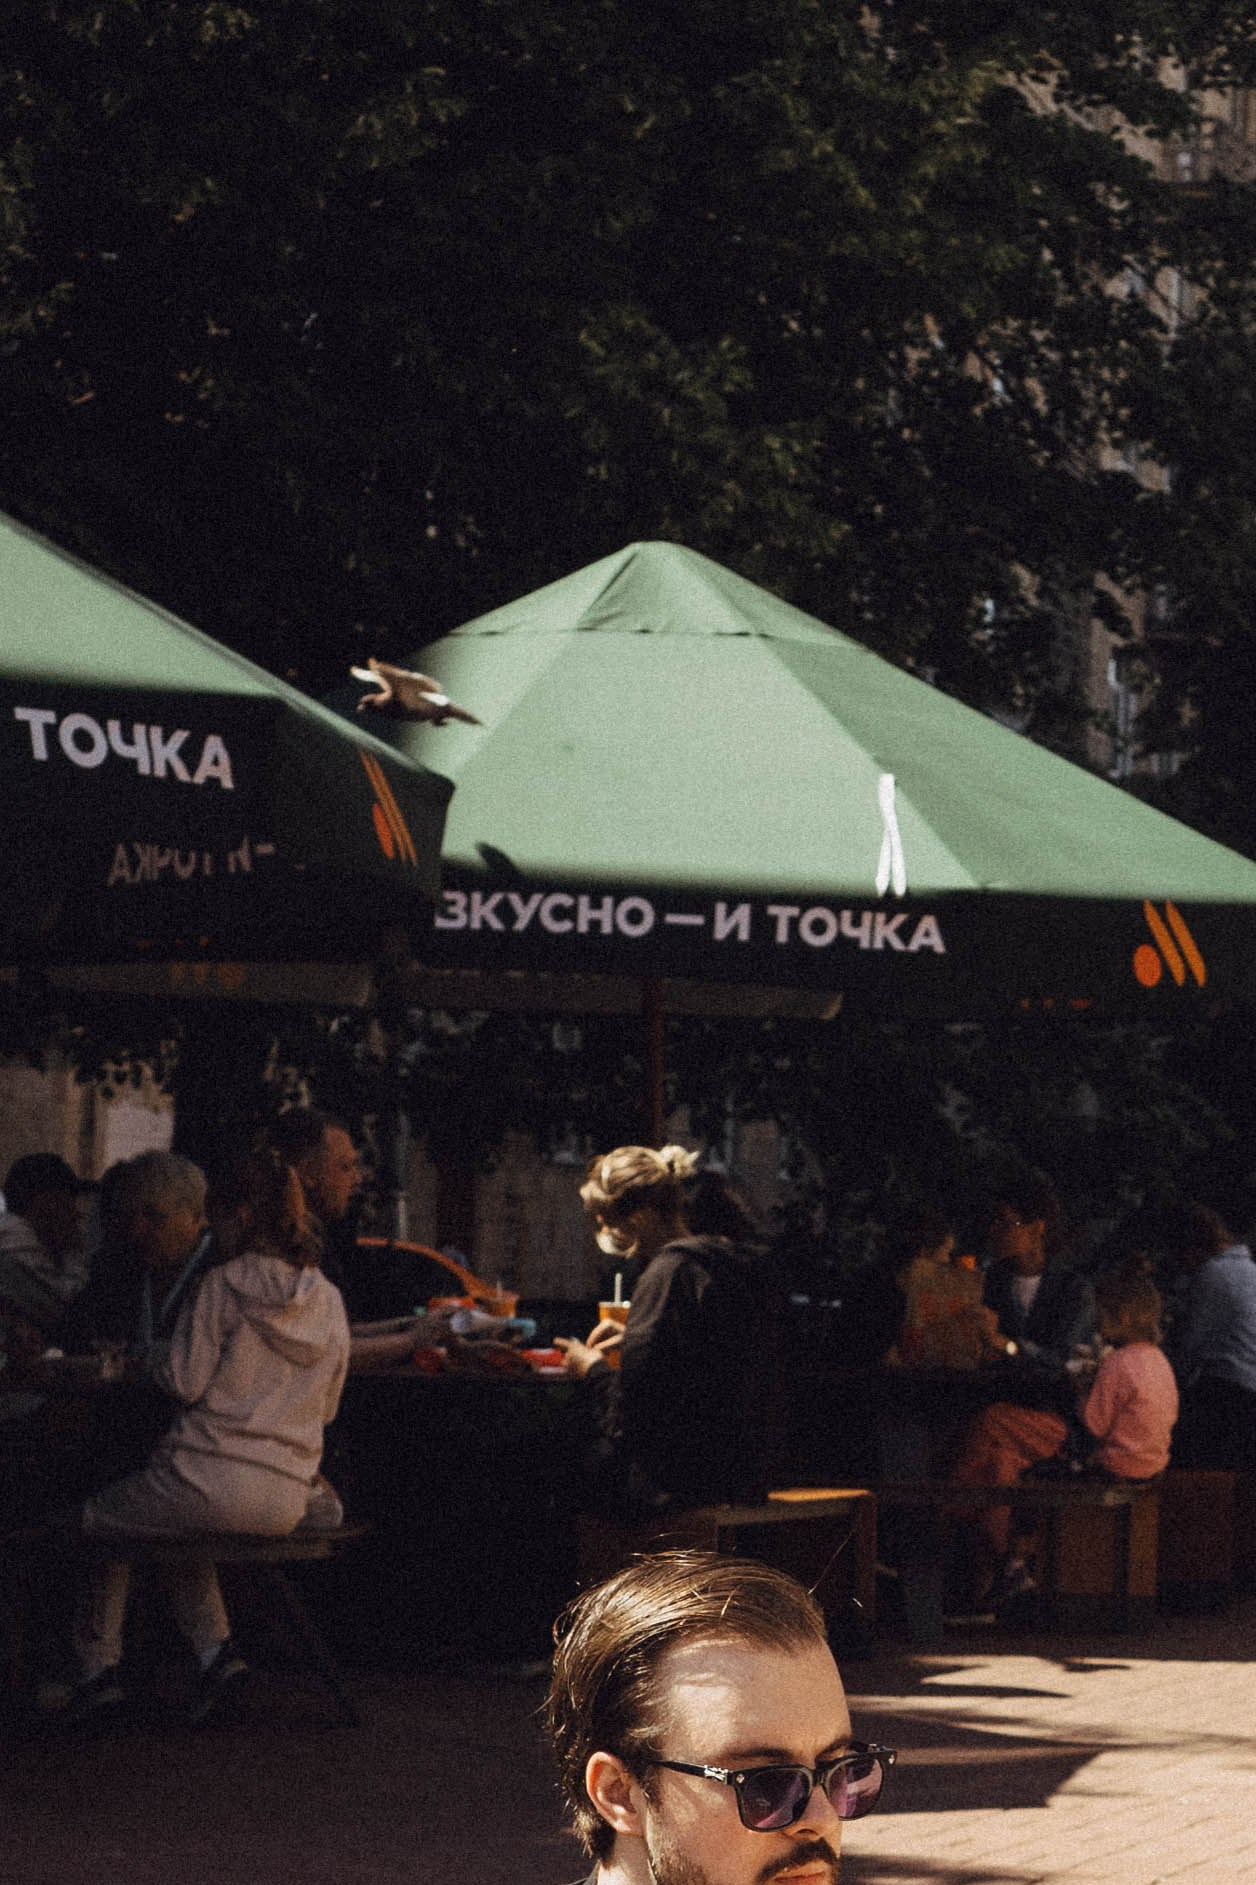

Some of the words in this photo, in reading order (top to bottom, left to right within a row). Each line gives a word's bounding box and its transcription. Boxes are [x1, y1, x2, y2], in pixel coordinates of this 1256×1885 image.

[13, 706, 235, 790] ТОЧКА
[434, 890, 656, 938] ВКУСНО
[713, 902, 751, 942] И
[766, 904, 947, 955] ТОЧКА
